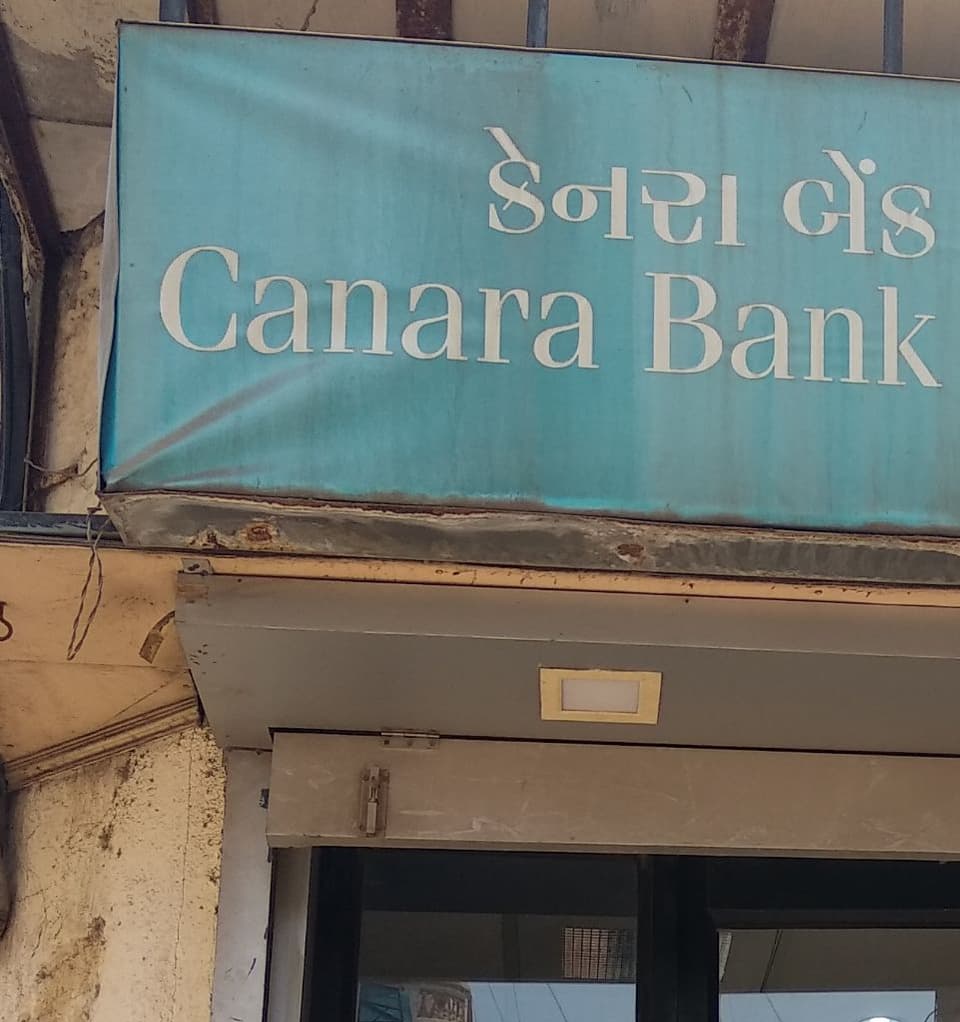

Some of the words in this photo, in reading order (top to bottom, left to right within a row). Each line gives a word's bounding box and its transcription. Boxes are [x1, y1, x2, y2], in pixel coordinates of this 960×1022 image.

[484, 127, 746, 247] કેનરા
[783, 149, 937, 259] બેંક
[159, 245, 600, 370] Canara
[644, 271, 943, 389] Bank
